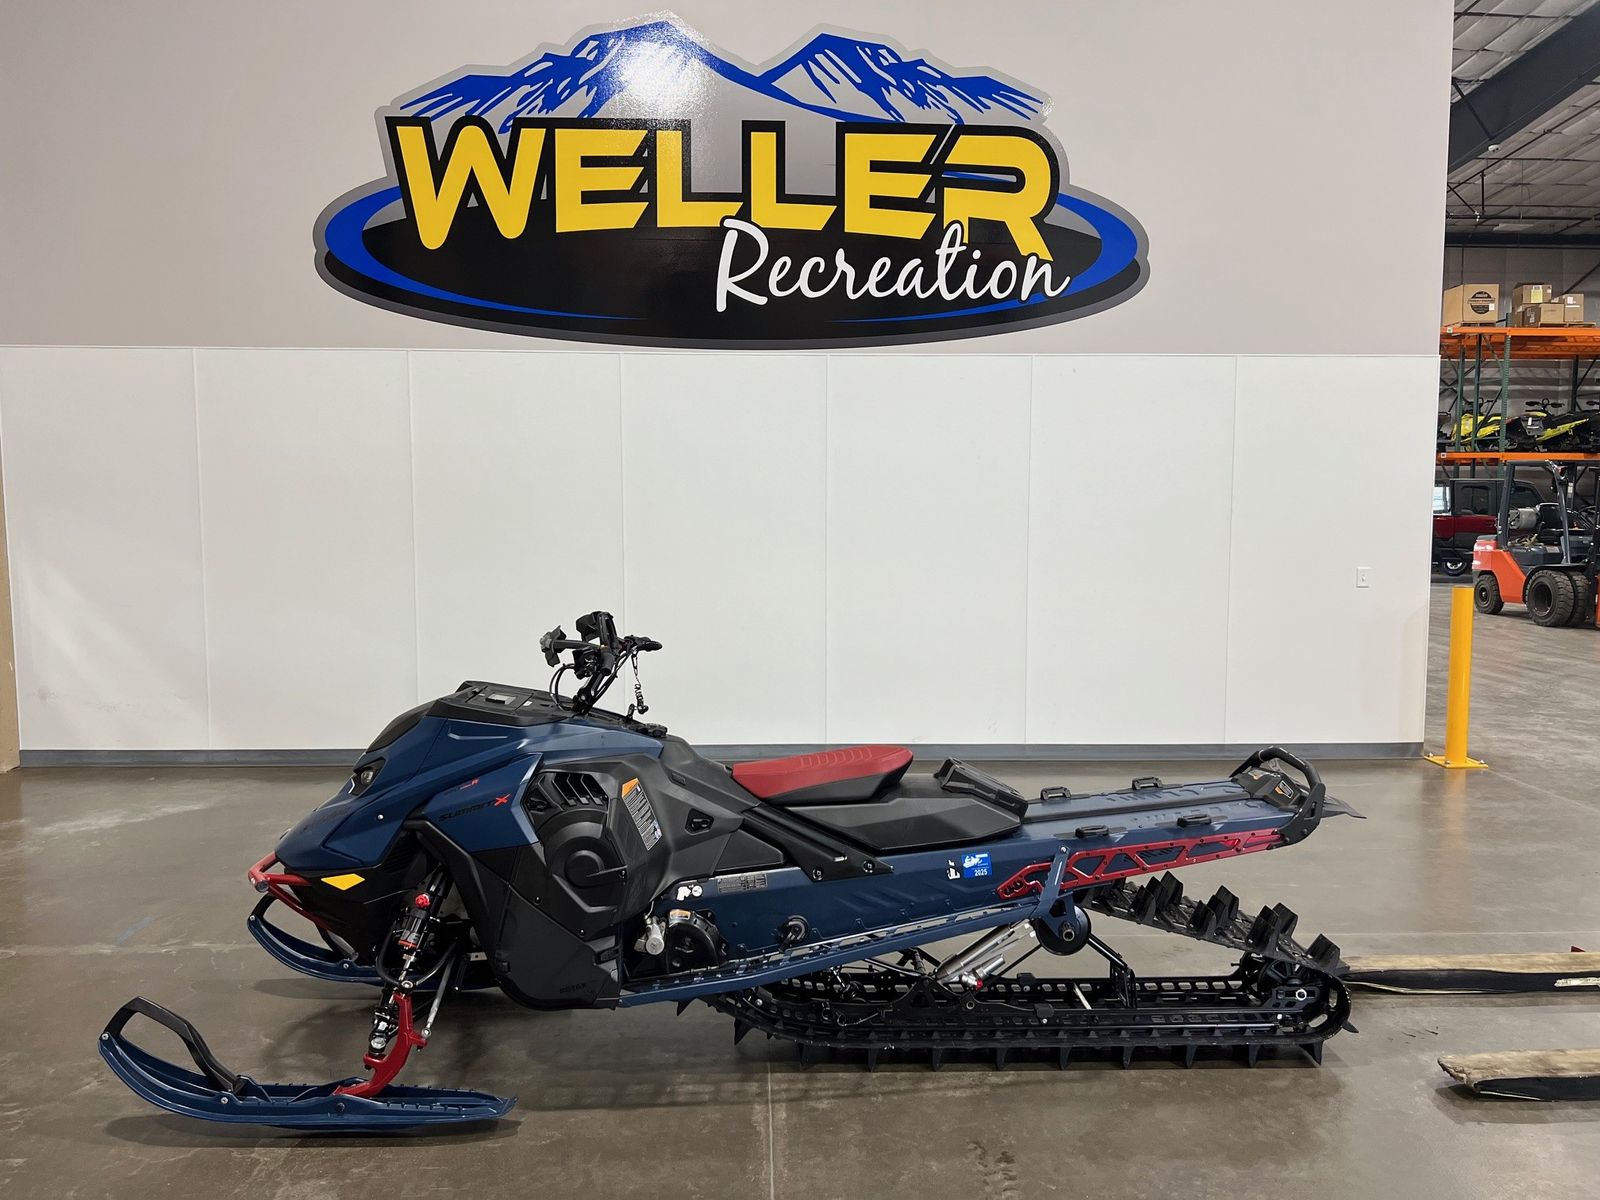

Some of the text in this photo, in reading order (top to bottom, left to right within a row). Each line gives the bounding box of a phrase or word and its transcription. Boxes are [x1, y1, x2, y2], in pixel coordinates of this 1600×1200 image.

[396, 125, 1053, 261] WELLER
[716, 218, 1071, 312] Recreation
[974, 868, 988, 877] 2025
